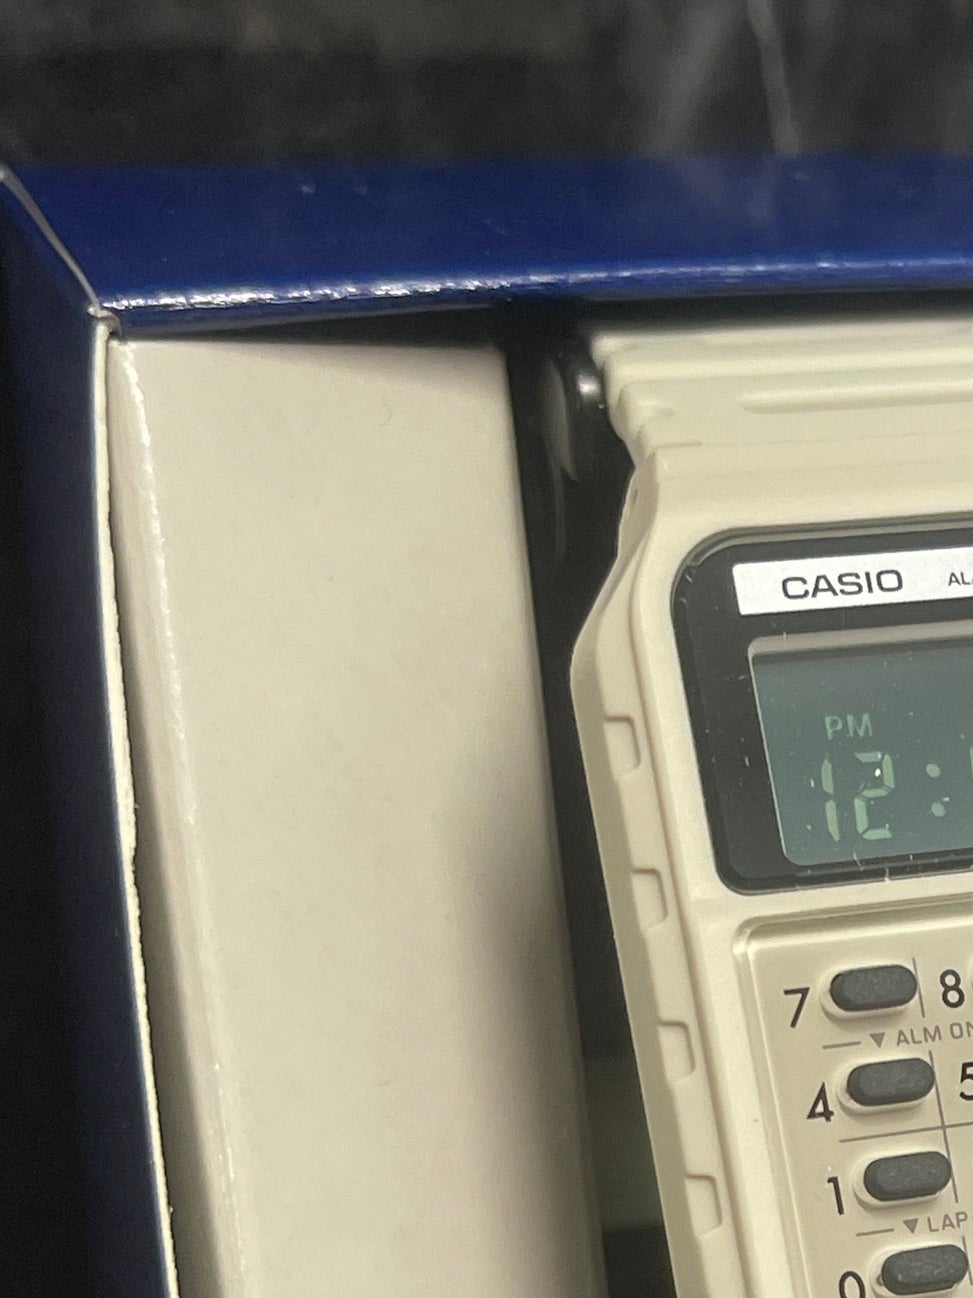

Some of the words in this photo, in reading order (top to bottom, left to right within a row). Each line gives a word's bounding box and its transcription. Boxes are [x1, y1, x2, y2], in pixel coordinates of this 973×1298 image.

[780, 567, 904, 601] CASIO
[824, 713, 874, 742] PM
[783, 987, 811, 1029] 7
[939, 968, 966, 1009] 8
[896, 1023, 944, 1047] ALM
[806, 1081, 836, 1123] 4
[826, 1176, 846, 1216] 1
